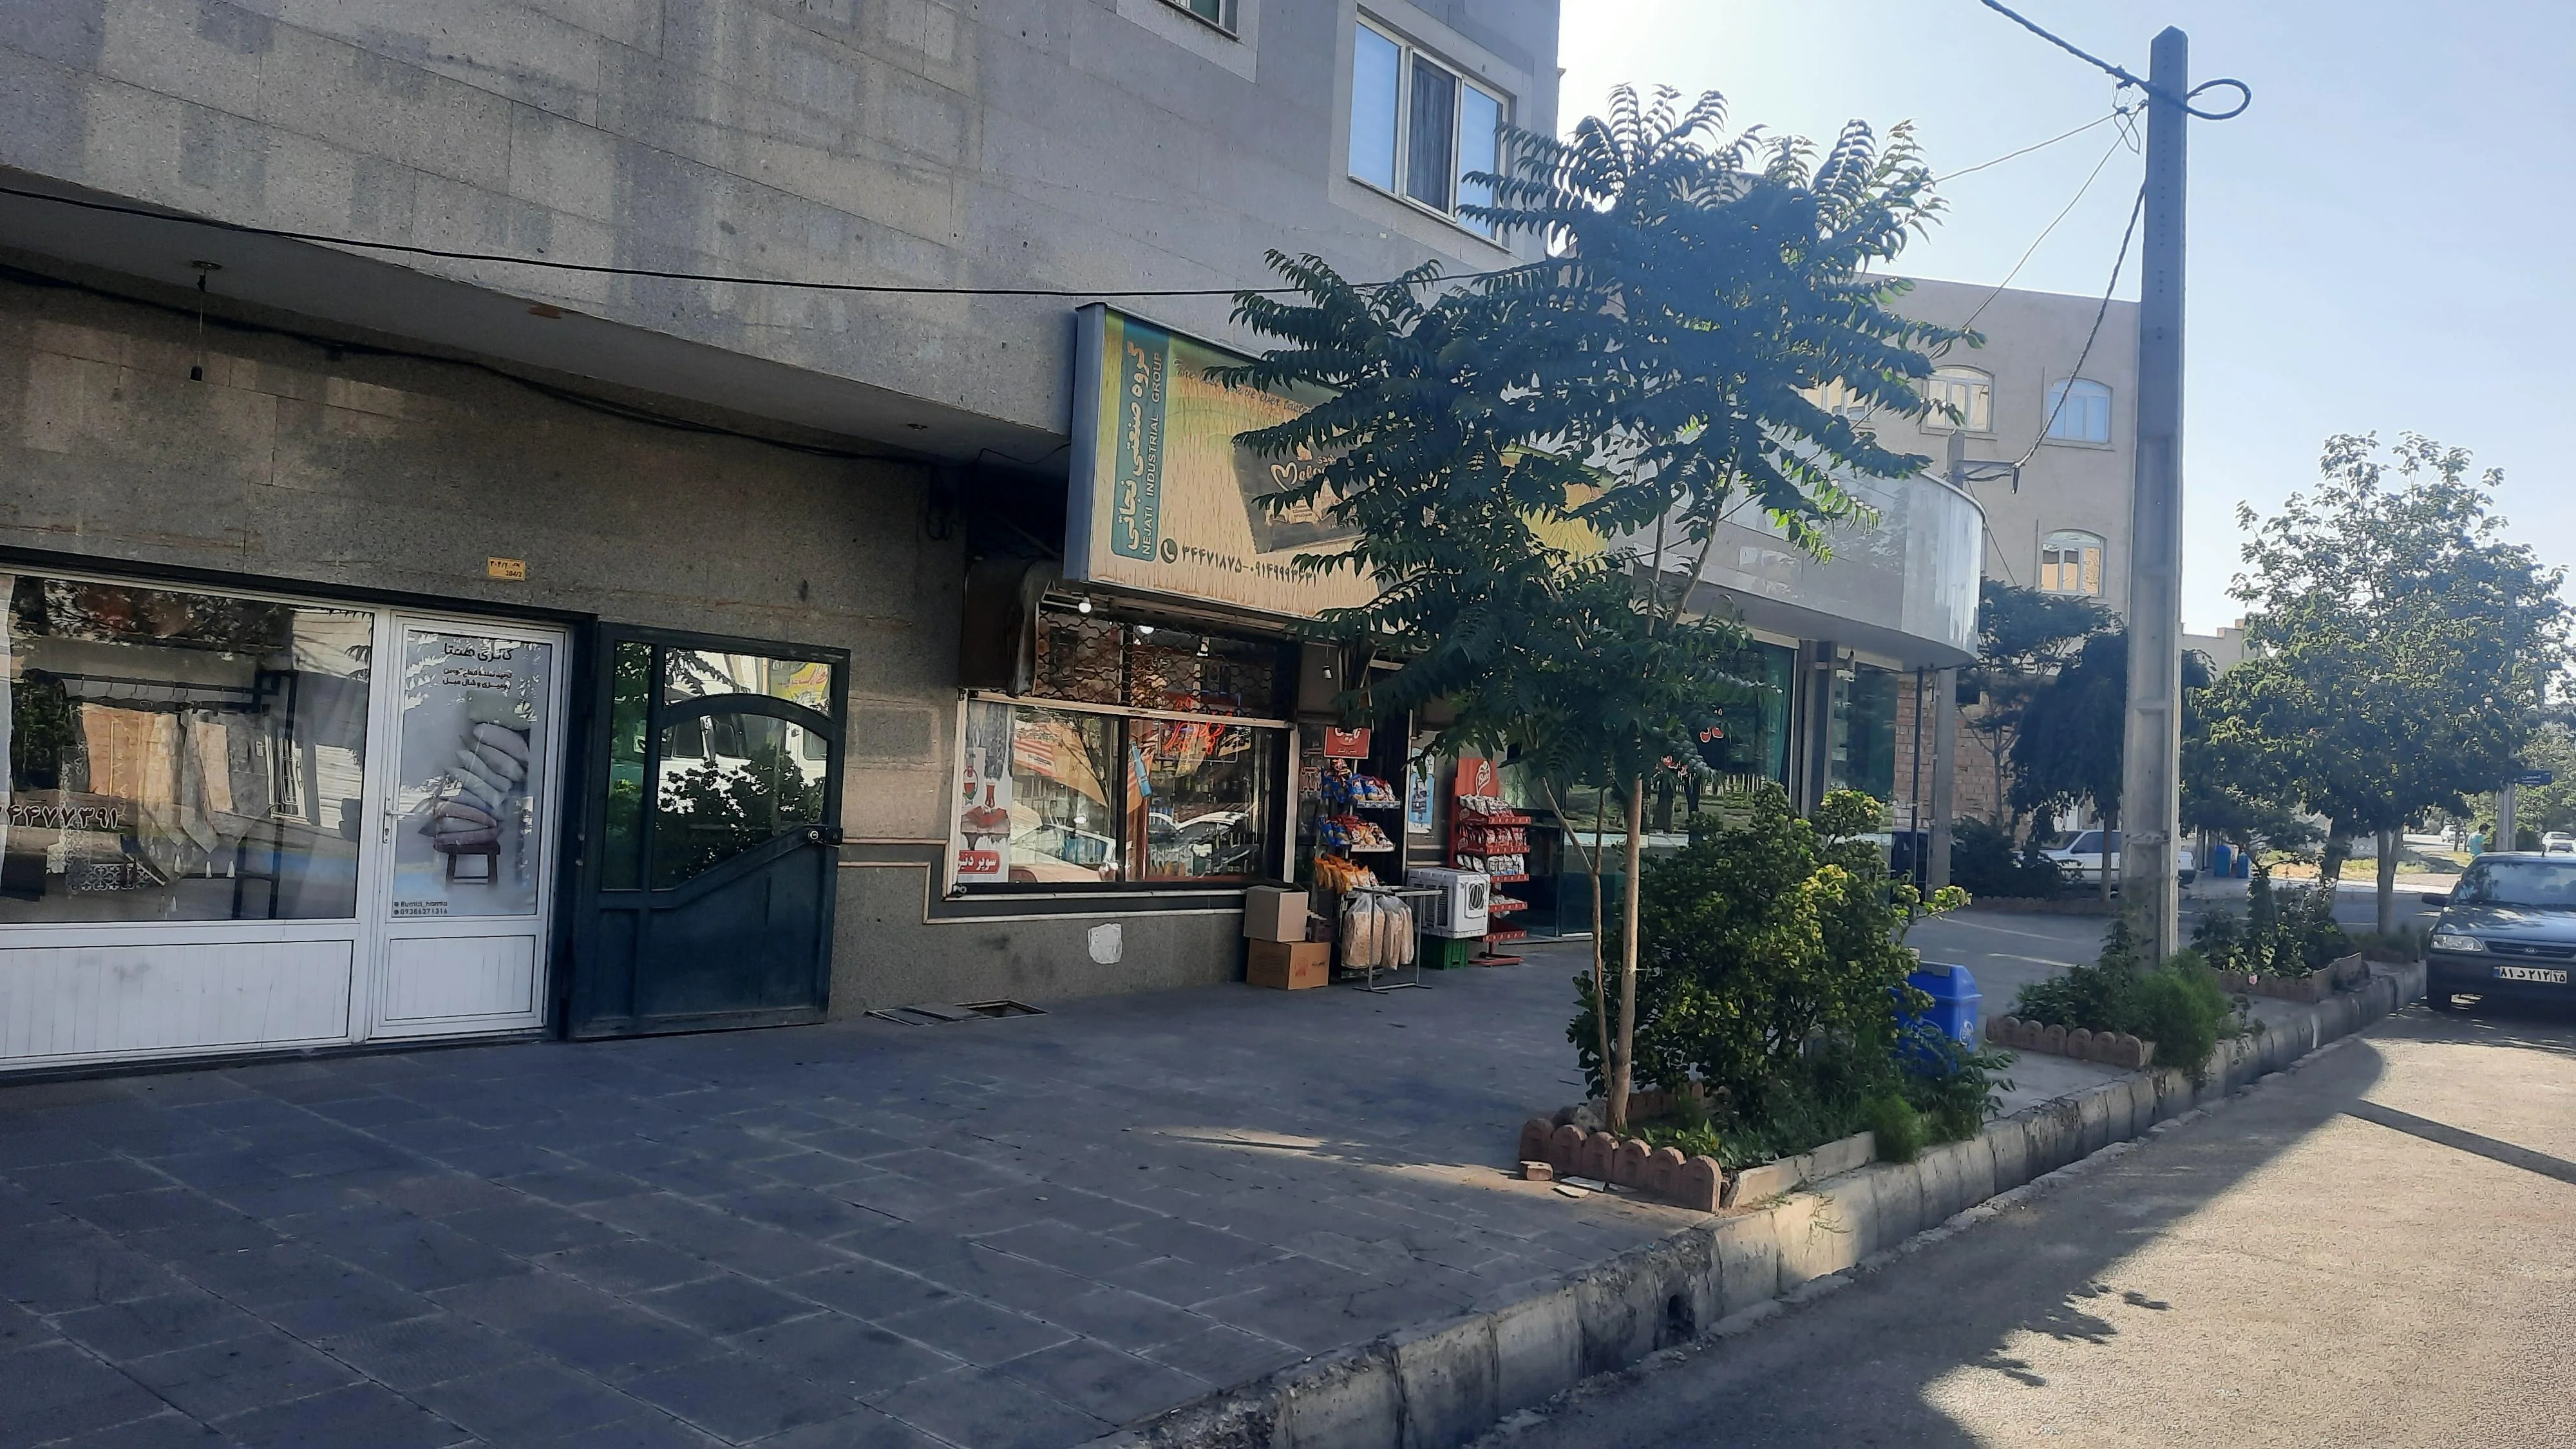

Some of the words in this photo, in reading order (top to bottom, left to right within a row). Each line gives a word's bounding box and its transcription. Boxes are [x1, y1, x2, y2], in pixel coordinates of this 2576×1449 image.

[1127, 341, 1150, 398] گروه
[1151, 352, 1162, 403] GROUP
[1126, 401, 1144, 476] صنعتی
[1146, 414, 1159, 497] INDUSTRIAL
[1118, 479, 1142, 550] نجاتی
[1142, 506, 1154, 554] NEJATI
[0, 804, 118, 829] ۴۴۷۷۳۹۱
[976, 857, 997, 871] سوپر
[2500, 968, 2514, 978] ۸۱
[2553, 973, 2566, 982] ۱۵
